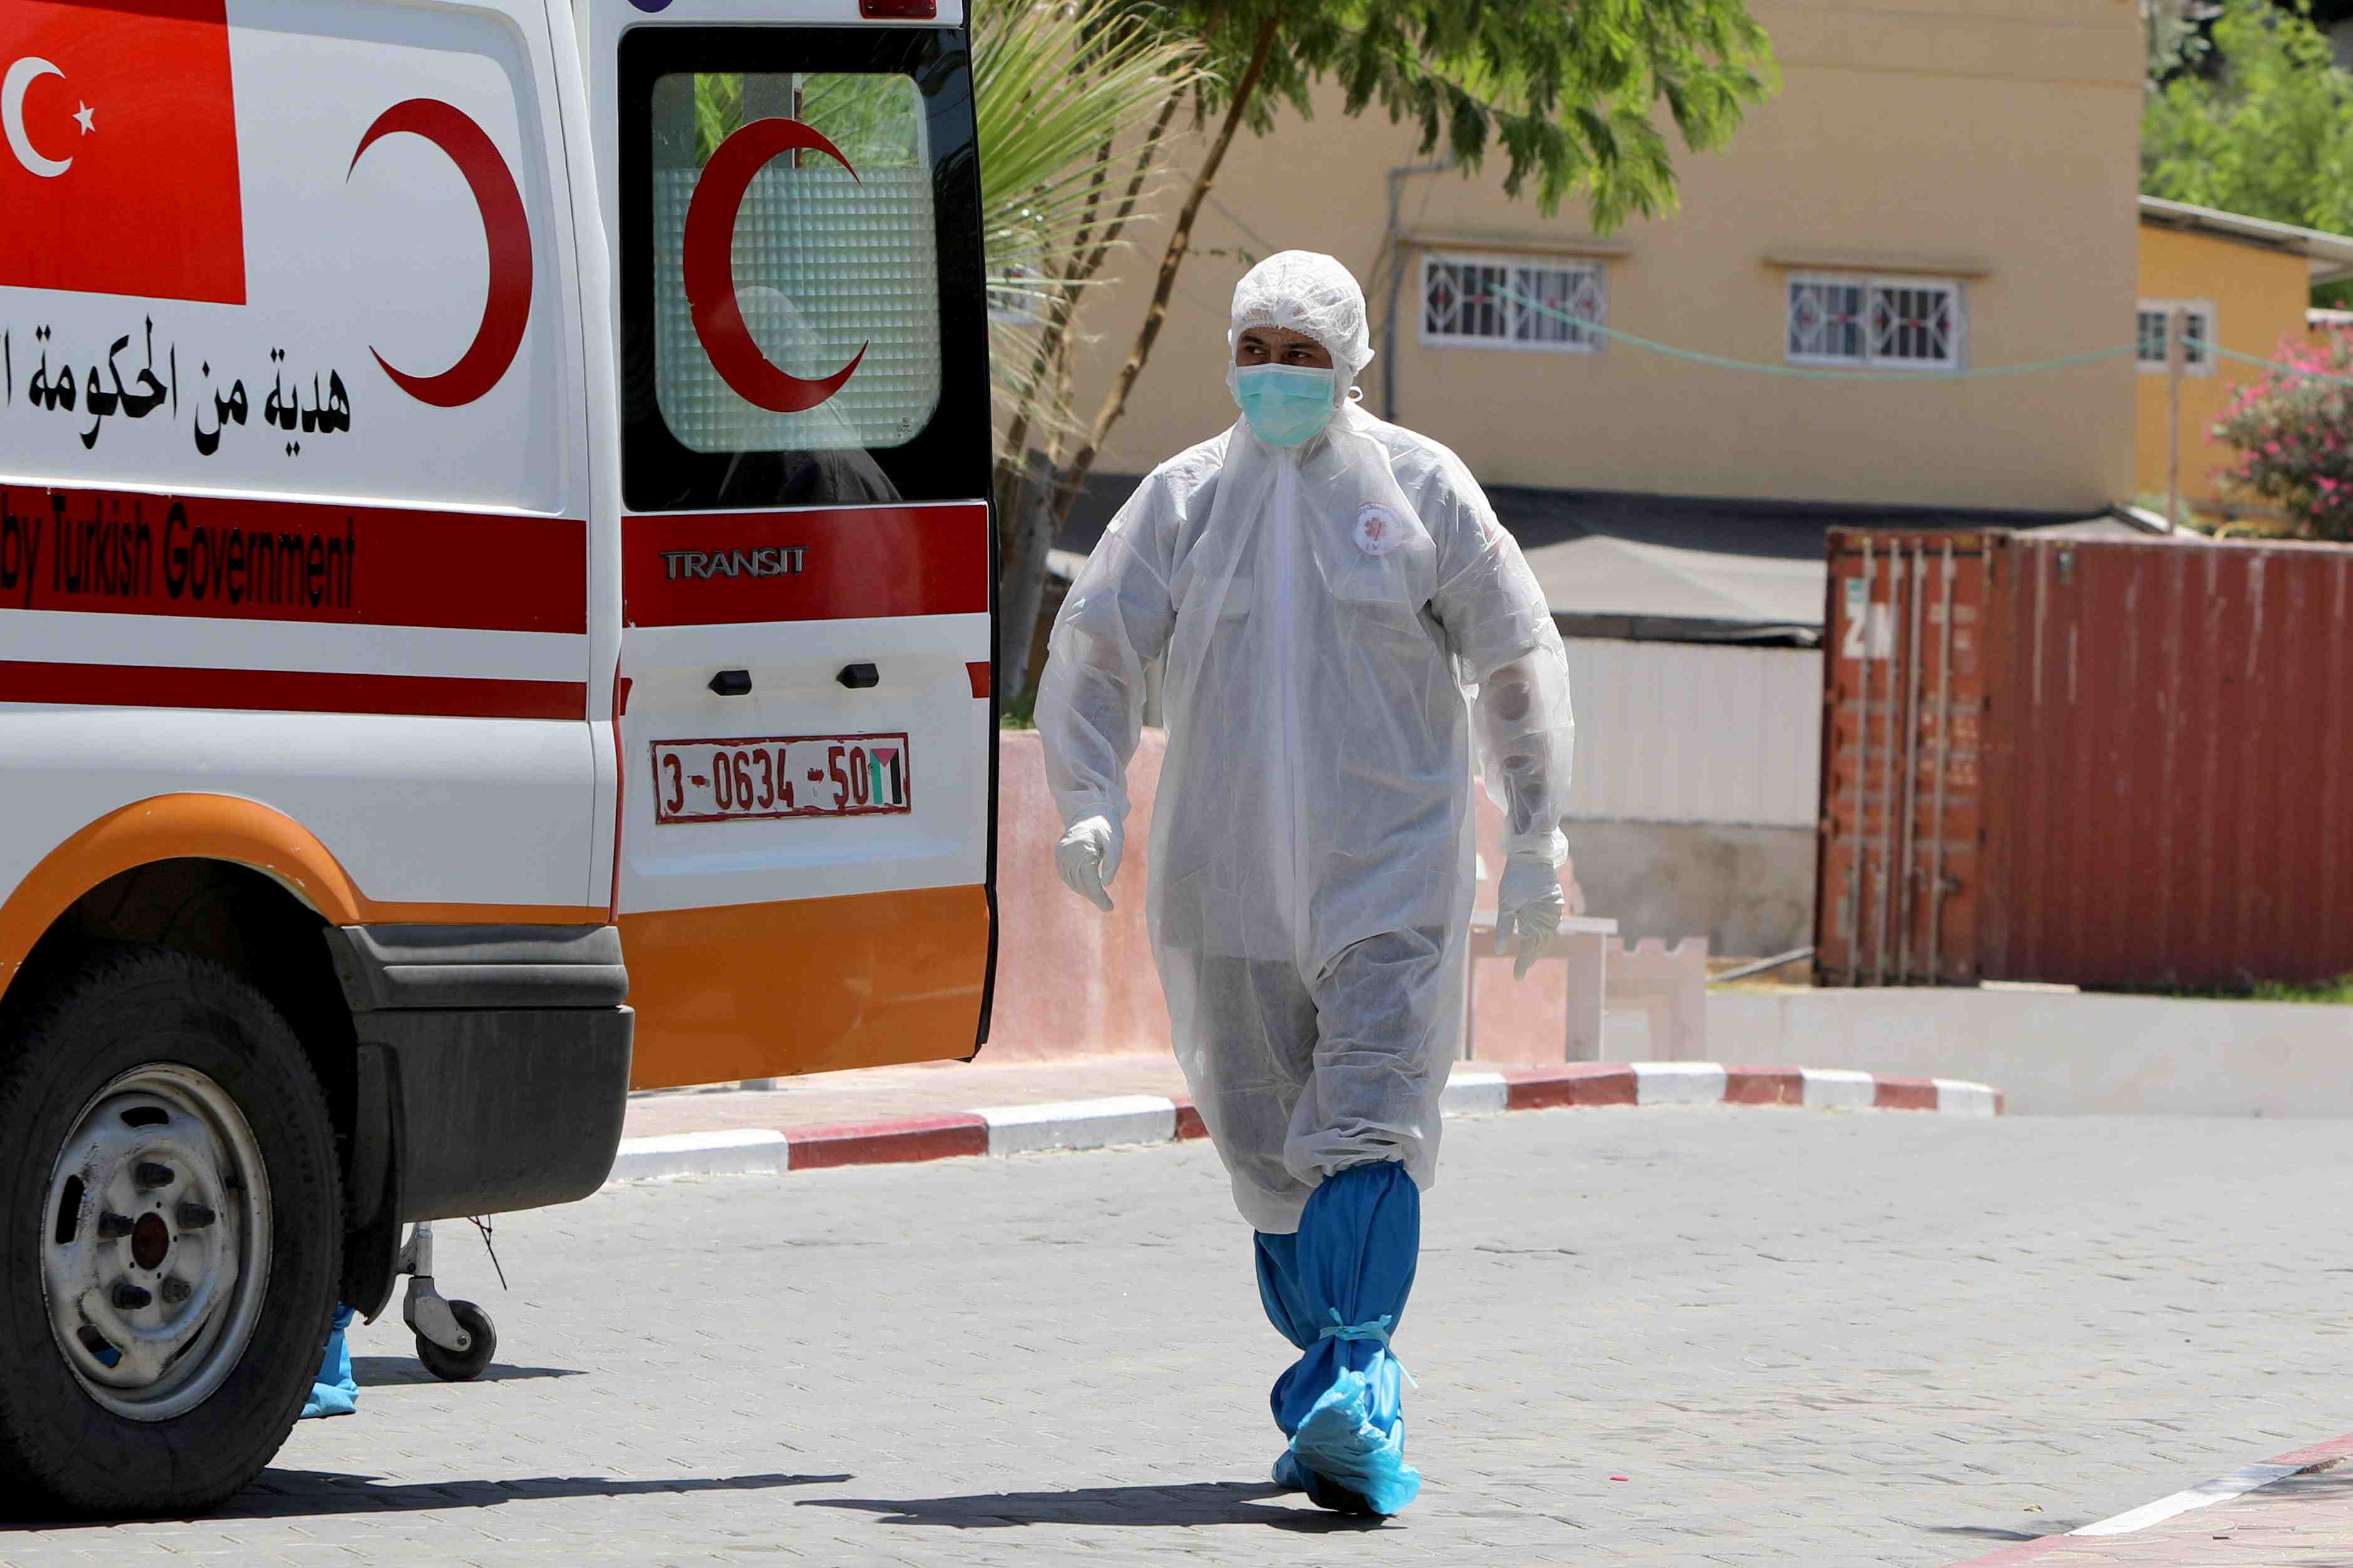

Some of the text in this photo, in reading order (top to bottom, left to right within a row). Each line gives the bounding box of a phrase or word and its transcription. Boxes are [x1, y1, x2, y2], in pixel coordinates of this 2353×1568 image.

[29, 315, 177, 449] الحكومة
[194, 361, 248, 456] من
[264, 347, 350, 457] هدية
[1, 491, 356, 609] by Turkish Government
[661, 547, 808, 580] TRANSIT
